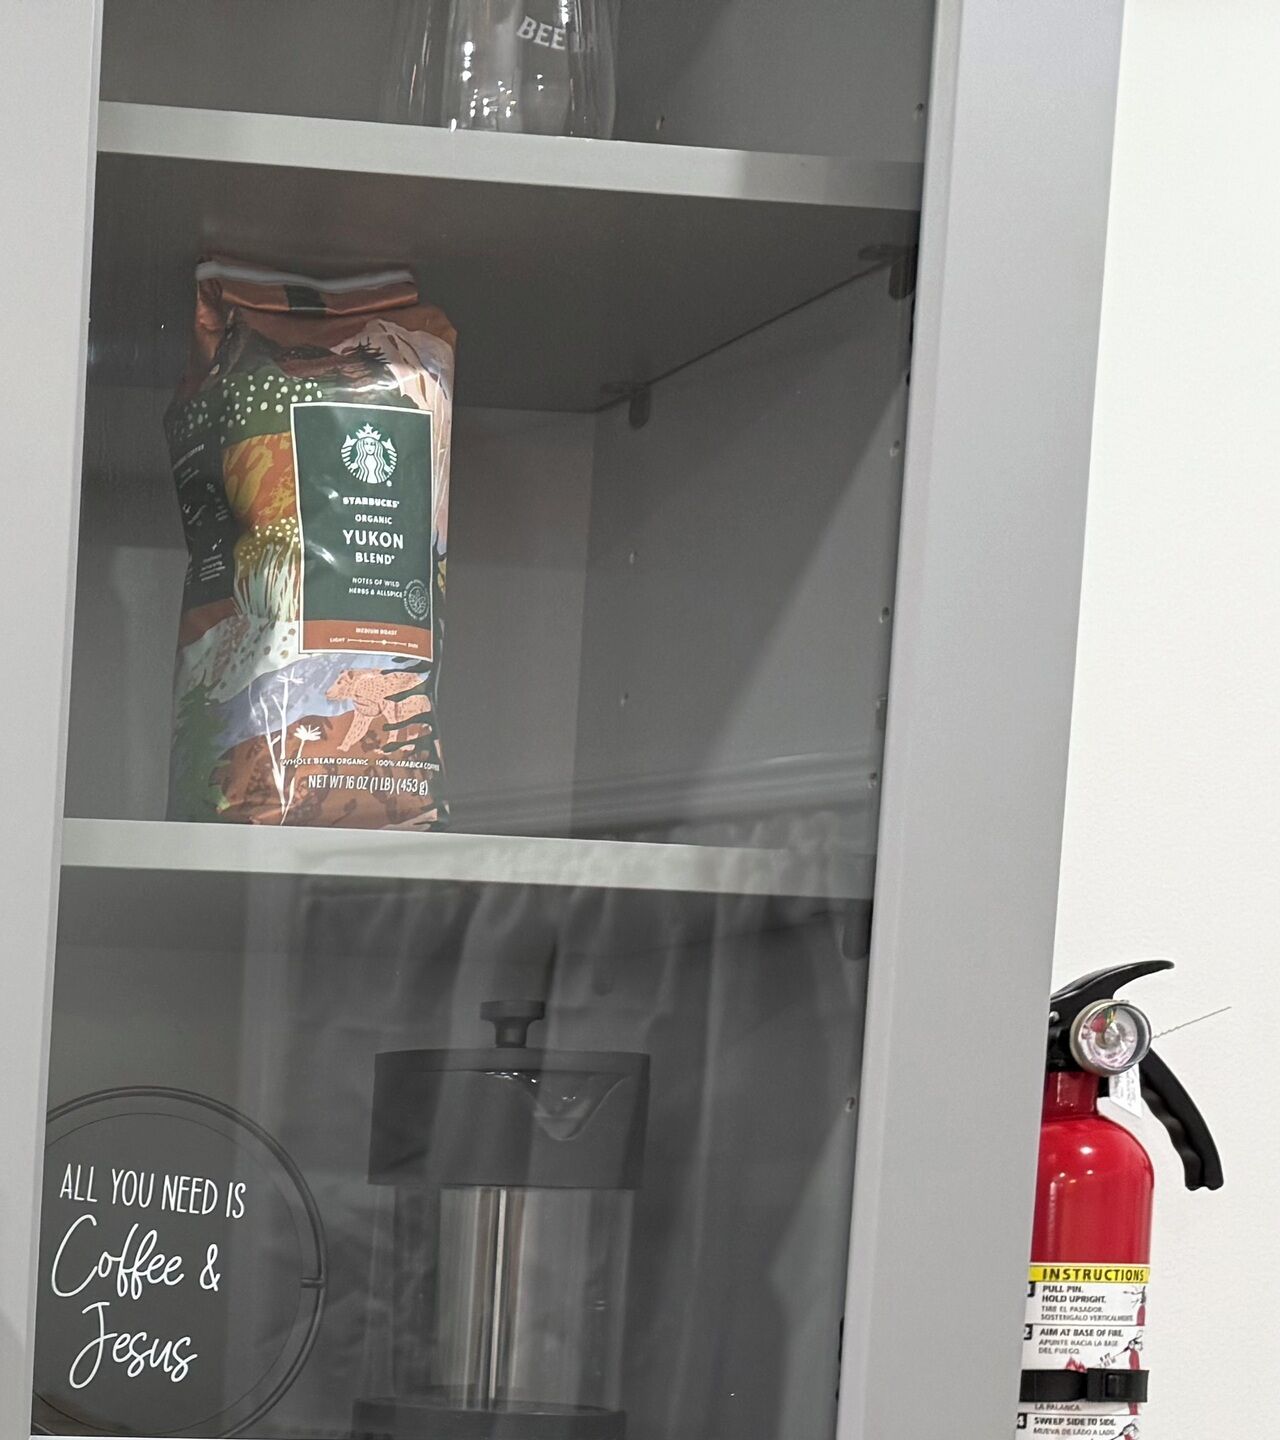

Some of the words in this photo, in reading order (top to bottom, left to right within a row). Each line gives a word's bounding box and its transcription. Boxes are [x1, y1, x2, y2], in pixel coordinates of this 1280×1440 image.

[343, 497, 399, 508] STARBUCKS
[355, 514, 393, 525] ORGANIC
[343, 529, 404, 550] YUKON
[355, 552, 394, 565] BLEND
[352, 577, 373, 586] NOTES
[374, 578, 383, 586] OF
[384, 580, 400, 588] WILD
[348, 588, 369, 596] HERBS
[314, 757, 335, 765] BEAN
[336, 758, 369, 766] ORGANIC
[395, 760, 424, 769] ARABICA
[308, 775, 329, 789] NET
[329, 775, 345, 790] WT
[345, 776, 354, 790] 16
[356, 776, 369, 790] OZ
[379, 778, 395, 794] LB)
[396, 778, 417, 795] (453
[418, 780, 429, 796] g)
[59, 1163, 98, 1203] ALL
[111, 1168, 155, 1208] YOU
[161, 1174, 218, 1215] NEED
[226, 1182, 247, 1219] IS
[51, 1214, 185, 1300] Coffee
[199, 1243, 221, 1291] &
[1042, 1268, 1145, 1281] INSTRUCTIONS
[1042, 1285, 1064, 1293] PULL
[1041, 1294, 1067, 1303] HOLD
[1069, 1295, 1107, 1304] UPRIGHT.
[1040, 1328, 1059, 1337] AIM
[1059, 1328, 1071, 1337] AT
[1073, 1329, 1095, 1337] BASE
[1096, 1329, 1107, 1337] OF
[69, 1301, 198, 1389] Jesus
[1034, 1417, 1064, 1426] SWEEP
[1066, 1418, 1085, 1426] SIDE
[1087, 1418, 1098, 1426] TO
